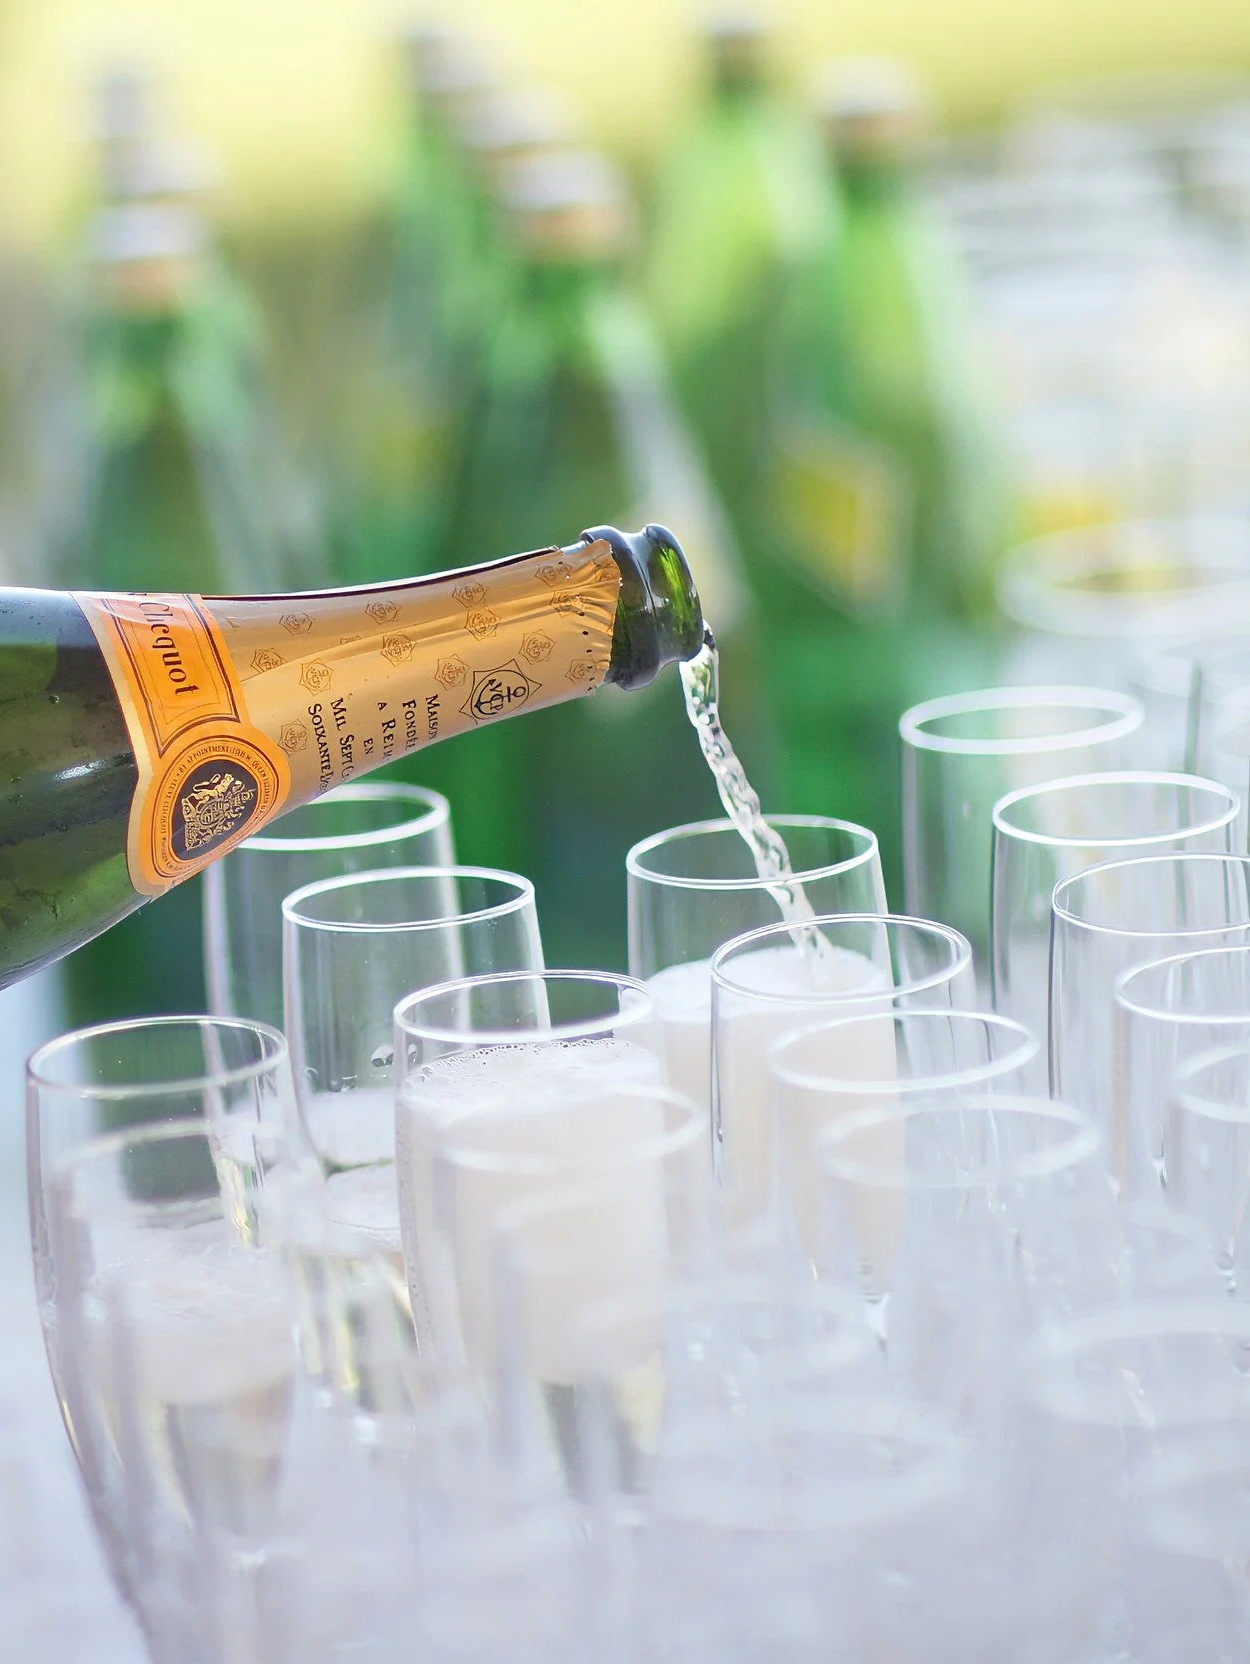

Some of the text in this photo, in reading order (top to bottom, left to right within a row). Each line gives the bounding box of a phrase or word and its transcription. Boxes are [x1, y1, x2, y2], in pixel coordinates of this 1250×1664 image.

[139, 603, 199, 694] Clicquot
[308, 703, 332, 772] SOIXANTE
[330, 698, 347, 731] MIL
[339, 735, 355, 765] SEPT
[363, 738, 374, 755] EN
[382, 718, 396, 760] REIM
